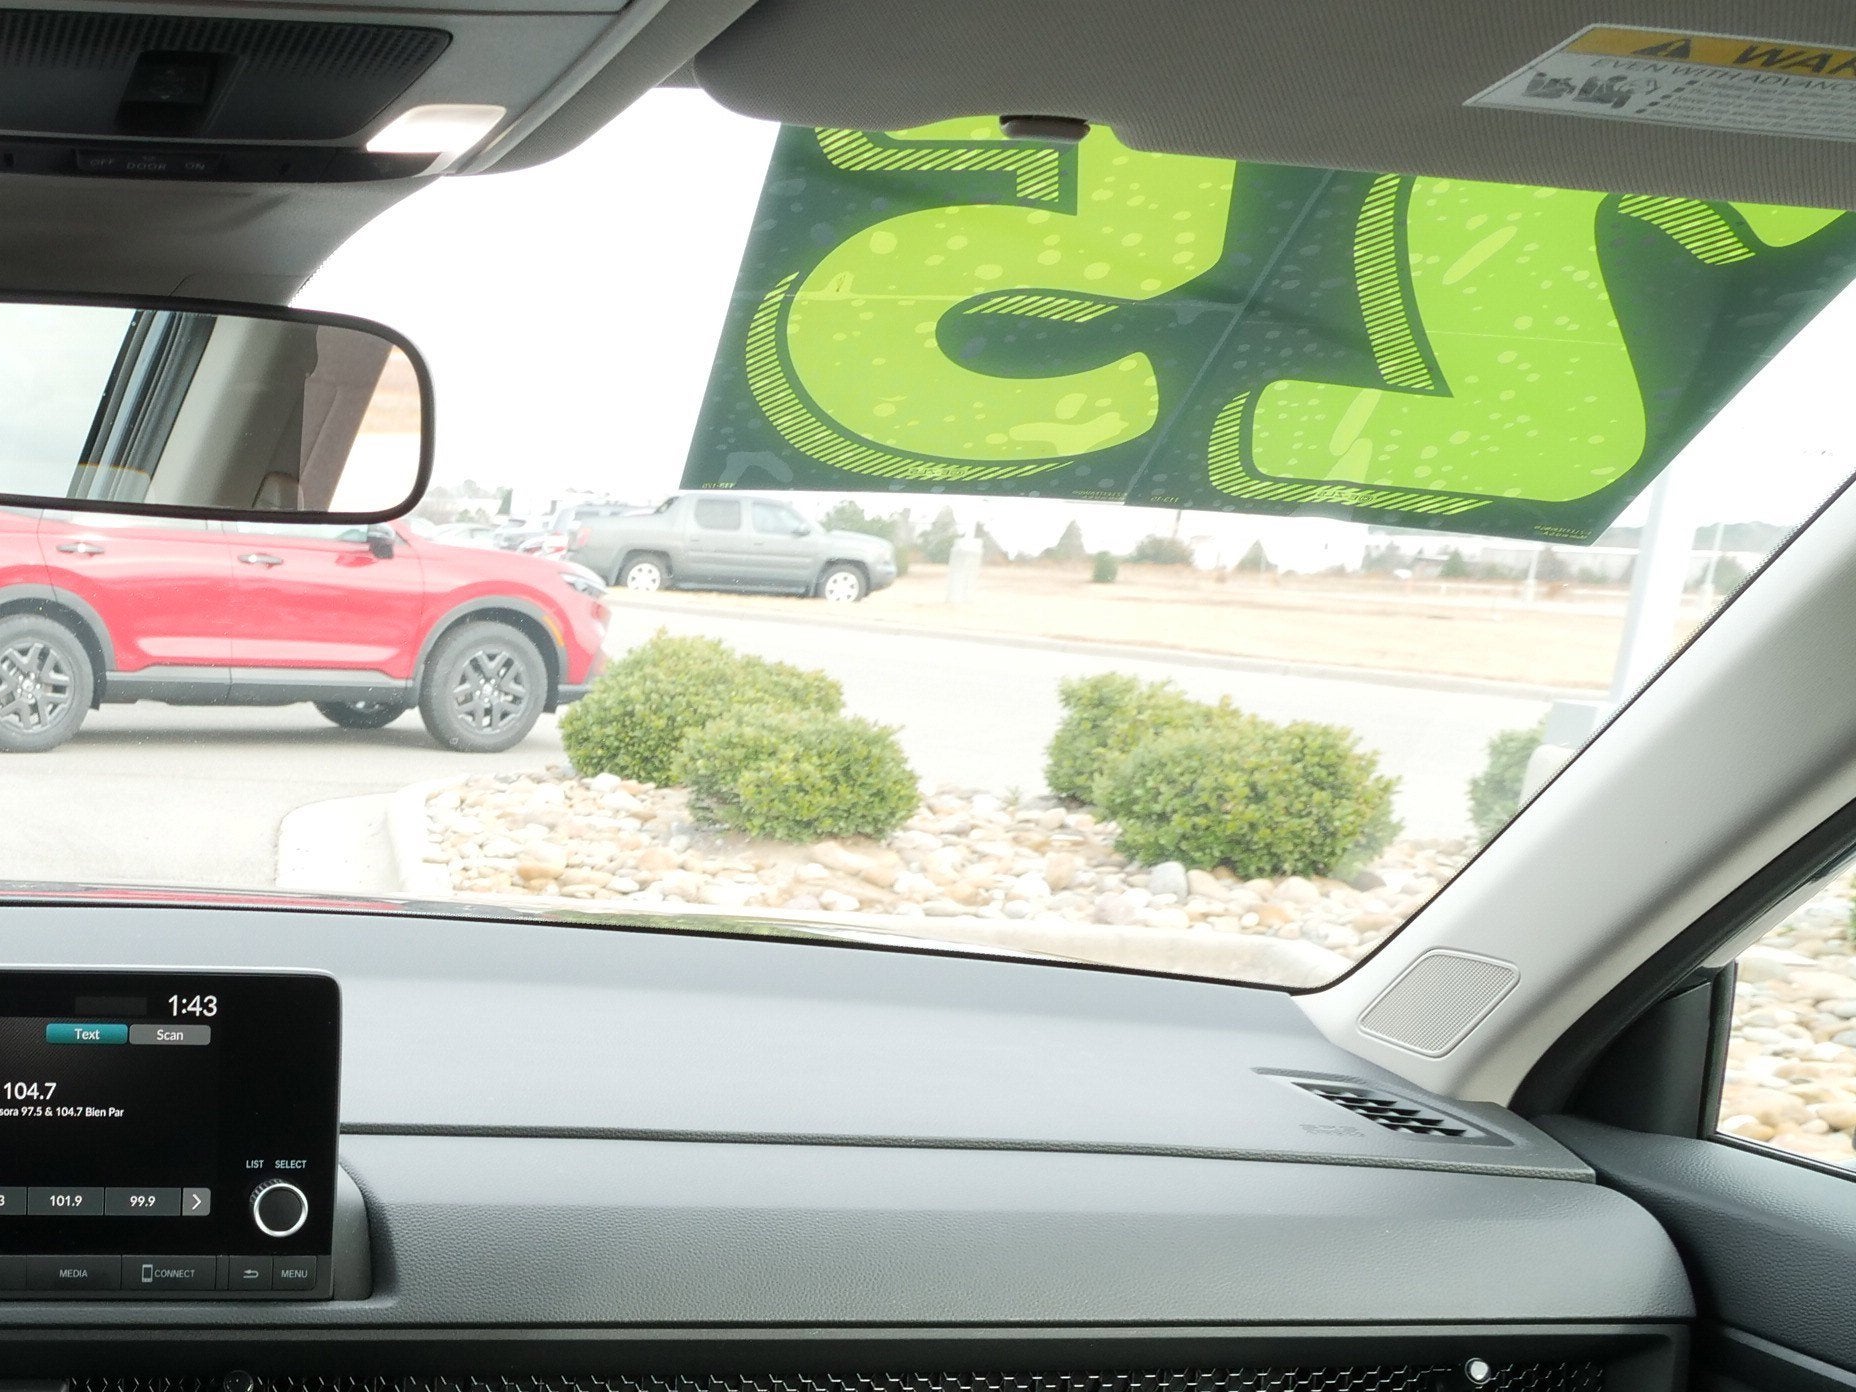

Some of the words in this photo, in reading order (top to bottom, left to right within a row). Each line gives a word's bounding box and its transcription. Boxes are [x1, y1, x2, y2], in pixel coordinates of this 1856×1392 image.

[1732, 45, 1856, 76] WA
[167, 994, 218, 1018] 1:43
[74, 1028, 101, 1041] Text
[156, 1029, 184, 1041] Scan
[3, 1081, 57, 1101] 104.7
[21, 1106, 43, 1118] 97.5
[44, 1106, 53, 1118] &
[55, 1106, 83, 1118] 104.7
[85, 1106, 107, 1118] Bien
[108, 1107, 125, 1118] Par
[245, 1159, 265, 1169] LIST
[274, 1159, 308, 1169] SELECT
[49, 1195, 83, 1207] 101.9
[129, 1195, 156, 1207] 99.9
[59, 1268, 88, 1279] MEDIA
[154, 1269, 195, 1279] CONNECT
[281, 1269, 308, 1279] MENU
